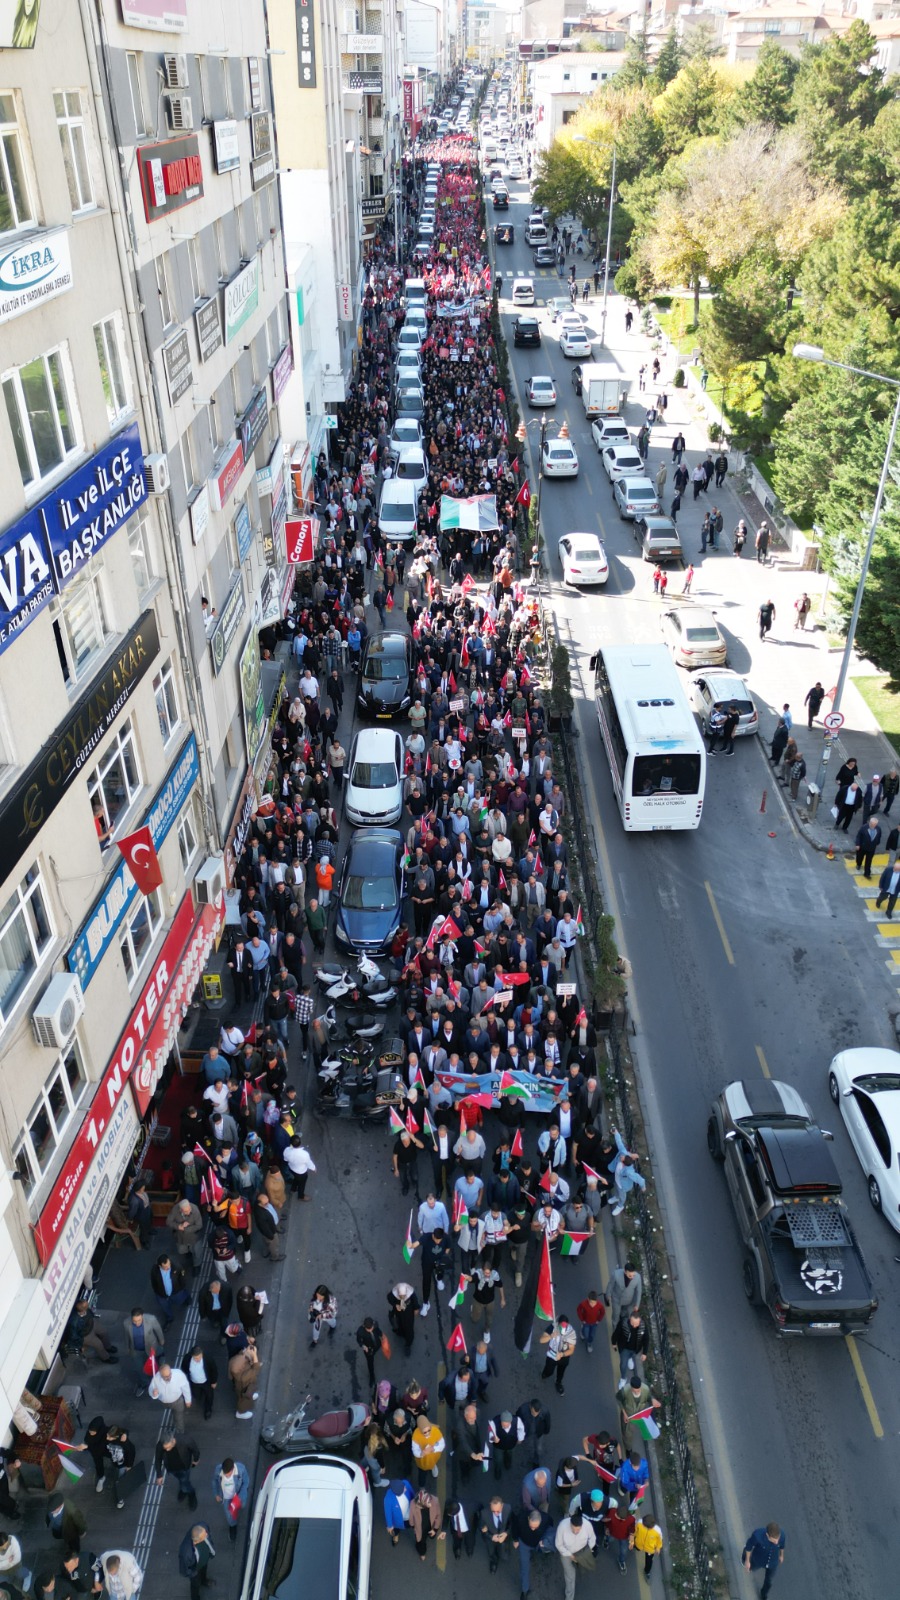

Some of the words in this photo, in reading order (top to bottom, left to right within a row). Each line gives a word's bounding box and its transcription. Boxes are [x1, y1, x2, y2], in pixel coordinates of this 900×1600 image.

[12, 247, 54, 278] İKRA
[2, 296, 19, 315] KÜLTÜR
[59, 474, 145, 579] BAŞKANLIĞI
[60, 498, 80, 530] İL
[78, 485, 98, 512] ve
[97, 447, 132, 496] İLÇE
[290, 523, 308, 562] Canon
[8, 602, 31, 637] ATILIM
[46, 685, 109, 786] CEYLAN
[112, 634, 147, 692] AKAR
[75, 725, 105, 769] GÜZELLİK
[106, 688, 129, 726] MERKEZİ
[86, 861, 137, 963] BURA
[172, 743, 195, 796] KURSU
[86, 1117, 105, 1148] 1.
[106, 959, 169, 1109] NOTER
